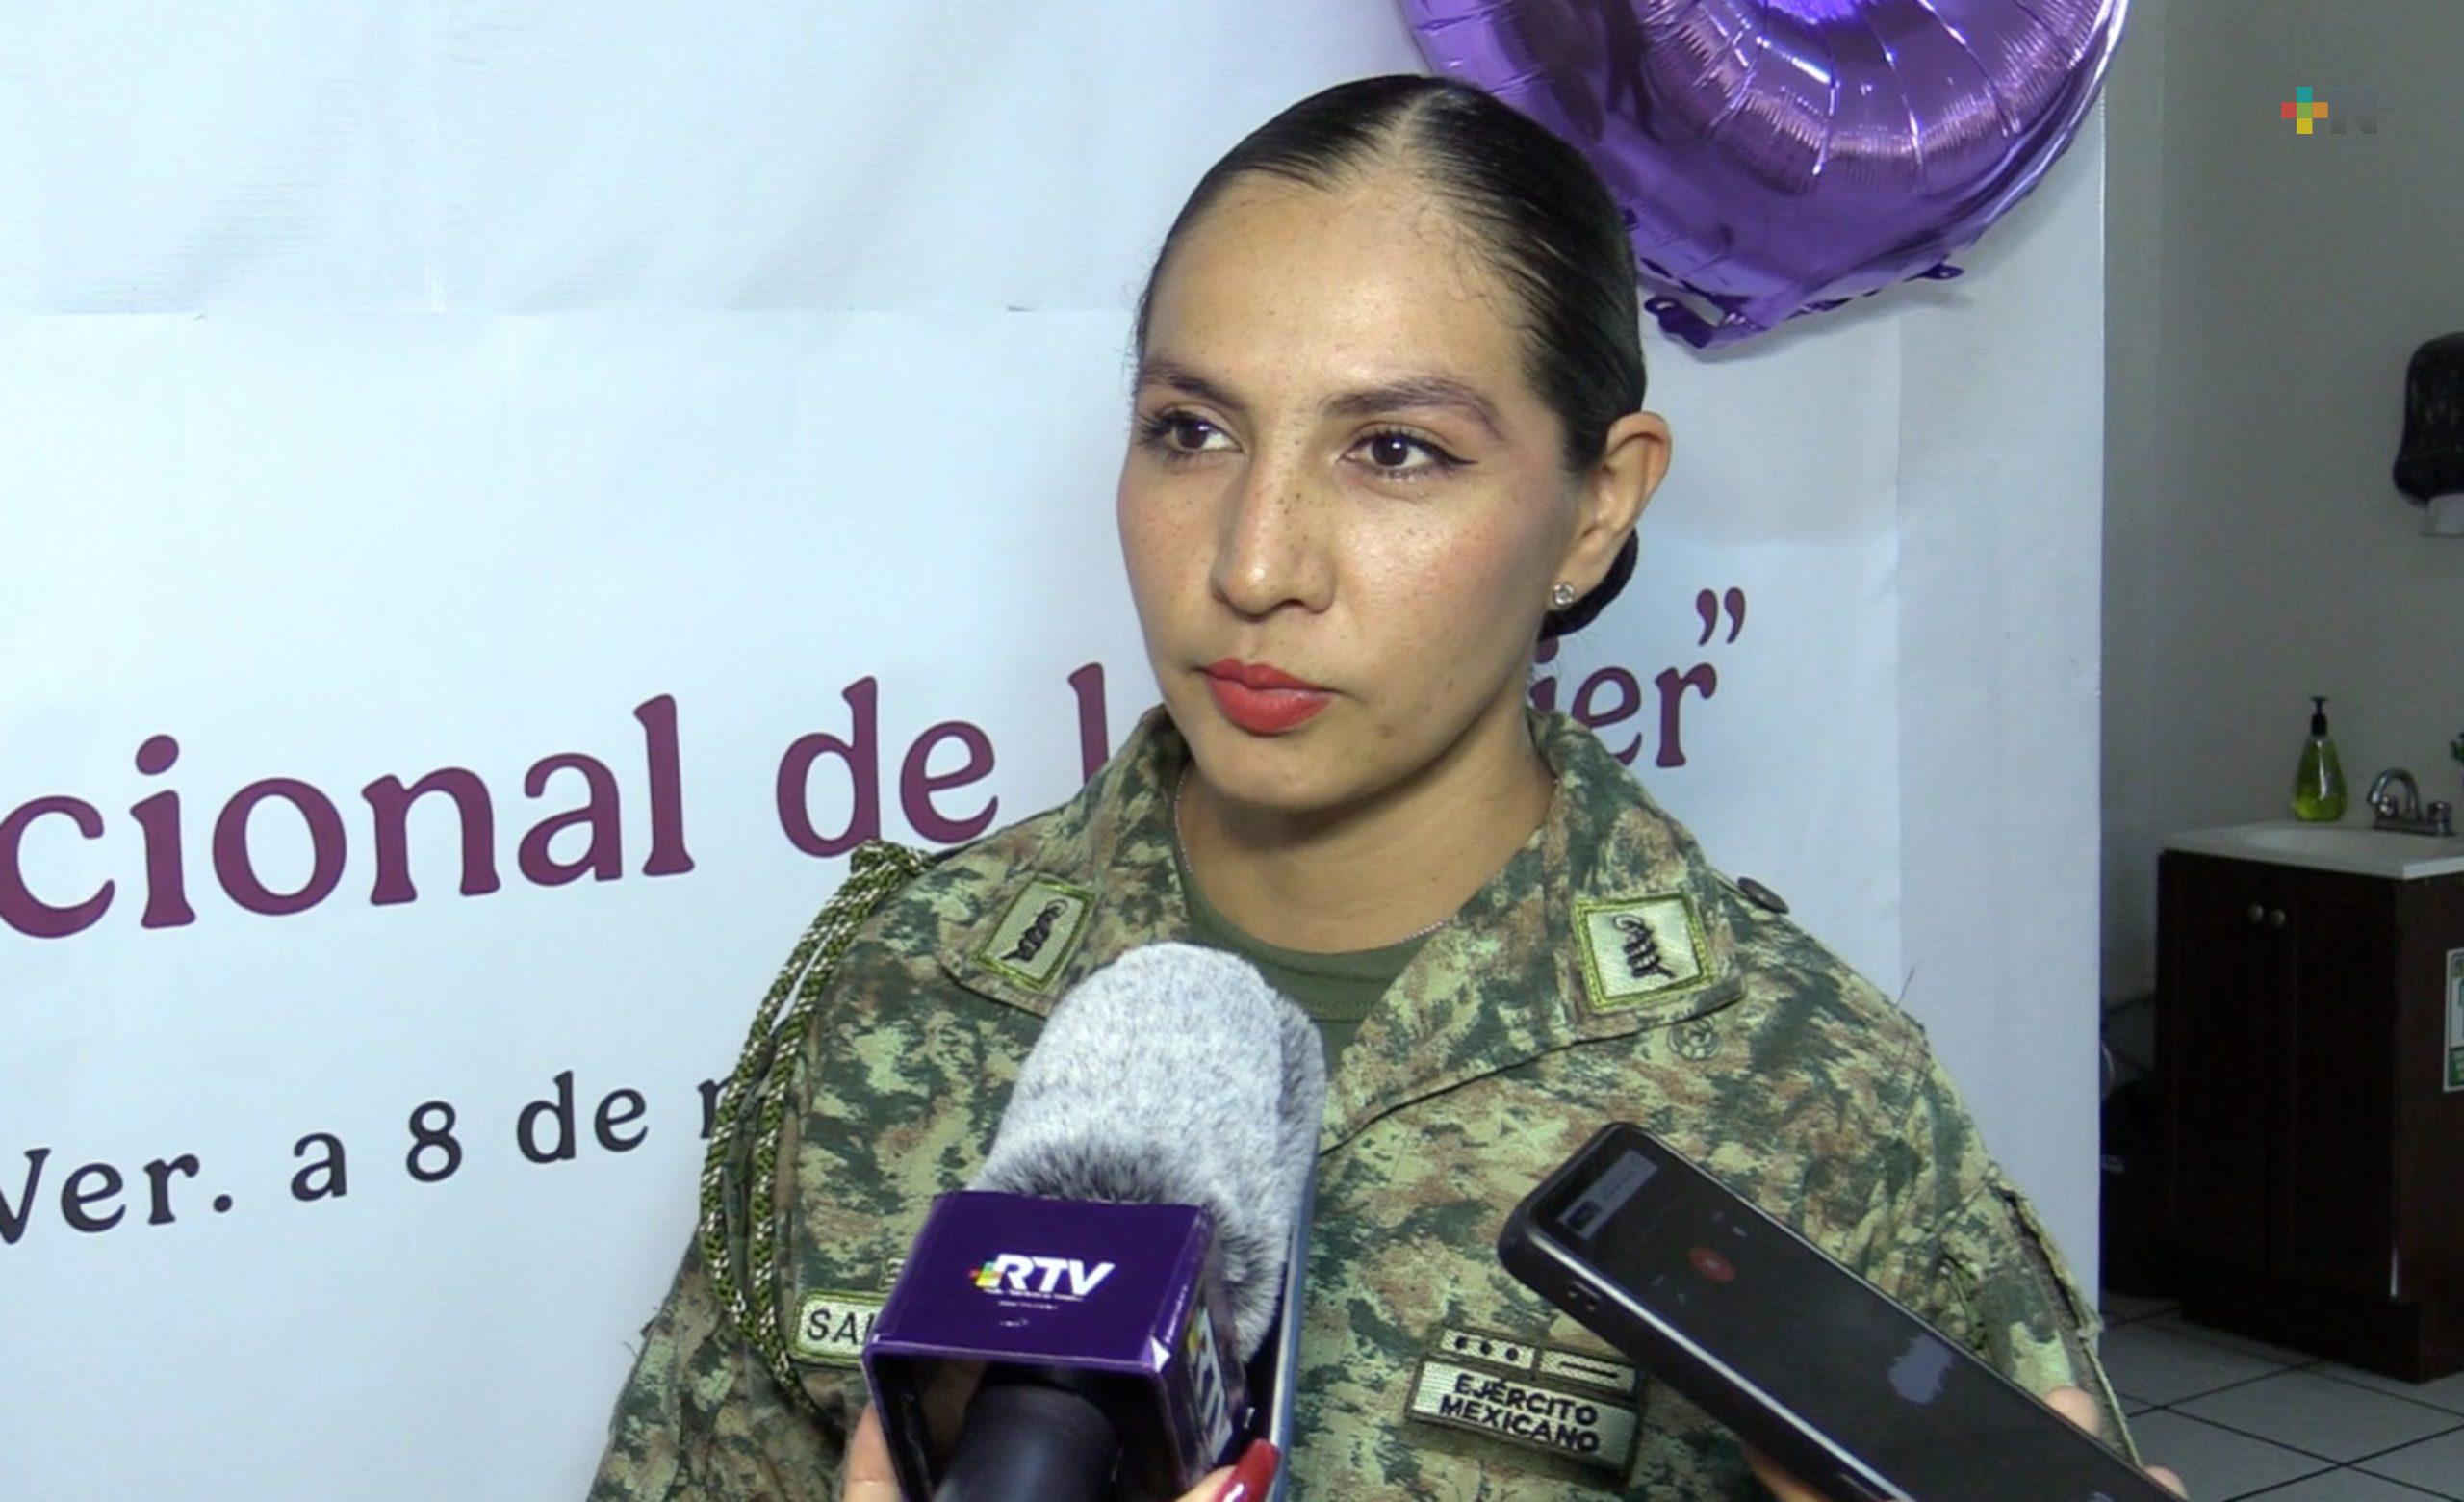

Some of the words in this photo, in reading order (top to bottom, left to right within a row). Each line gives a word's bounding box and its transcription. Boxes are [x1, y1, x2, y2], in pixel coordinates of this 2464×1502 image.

[0, 693, 695, 939] cional
[776, 675, 999, 858] de
[1067, 661, 1110, 787] l
[291, 1132, 347, 1202] a
[405, 1101, 463, 1183] 8
[517, 1070, 649, 1164] de
[988, 1253, 1116, 1296] RTV
[1439, 1393, 1600, 1453] MEXICANO
